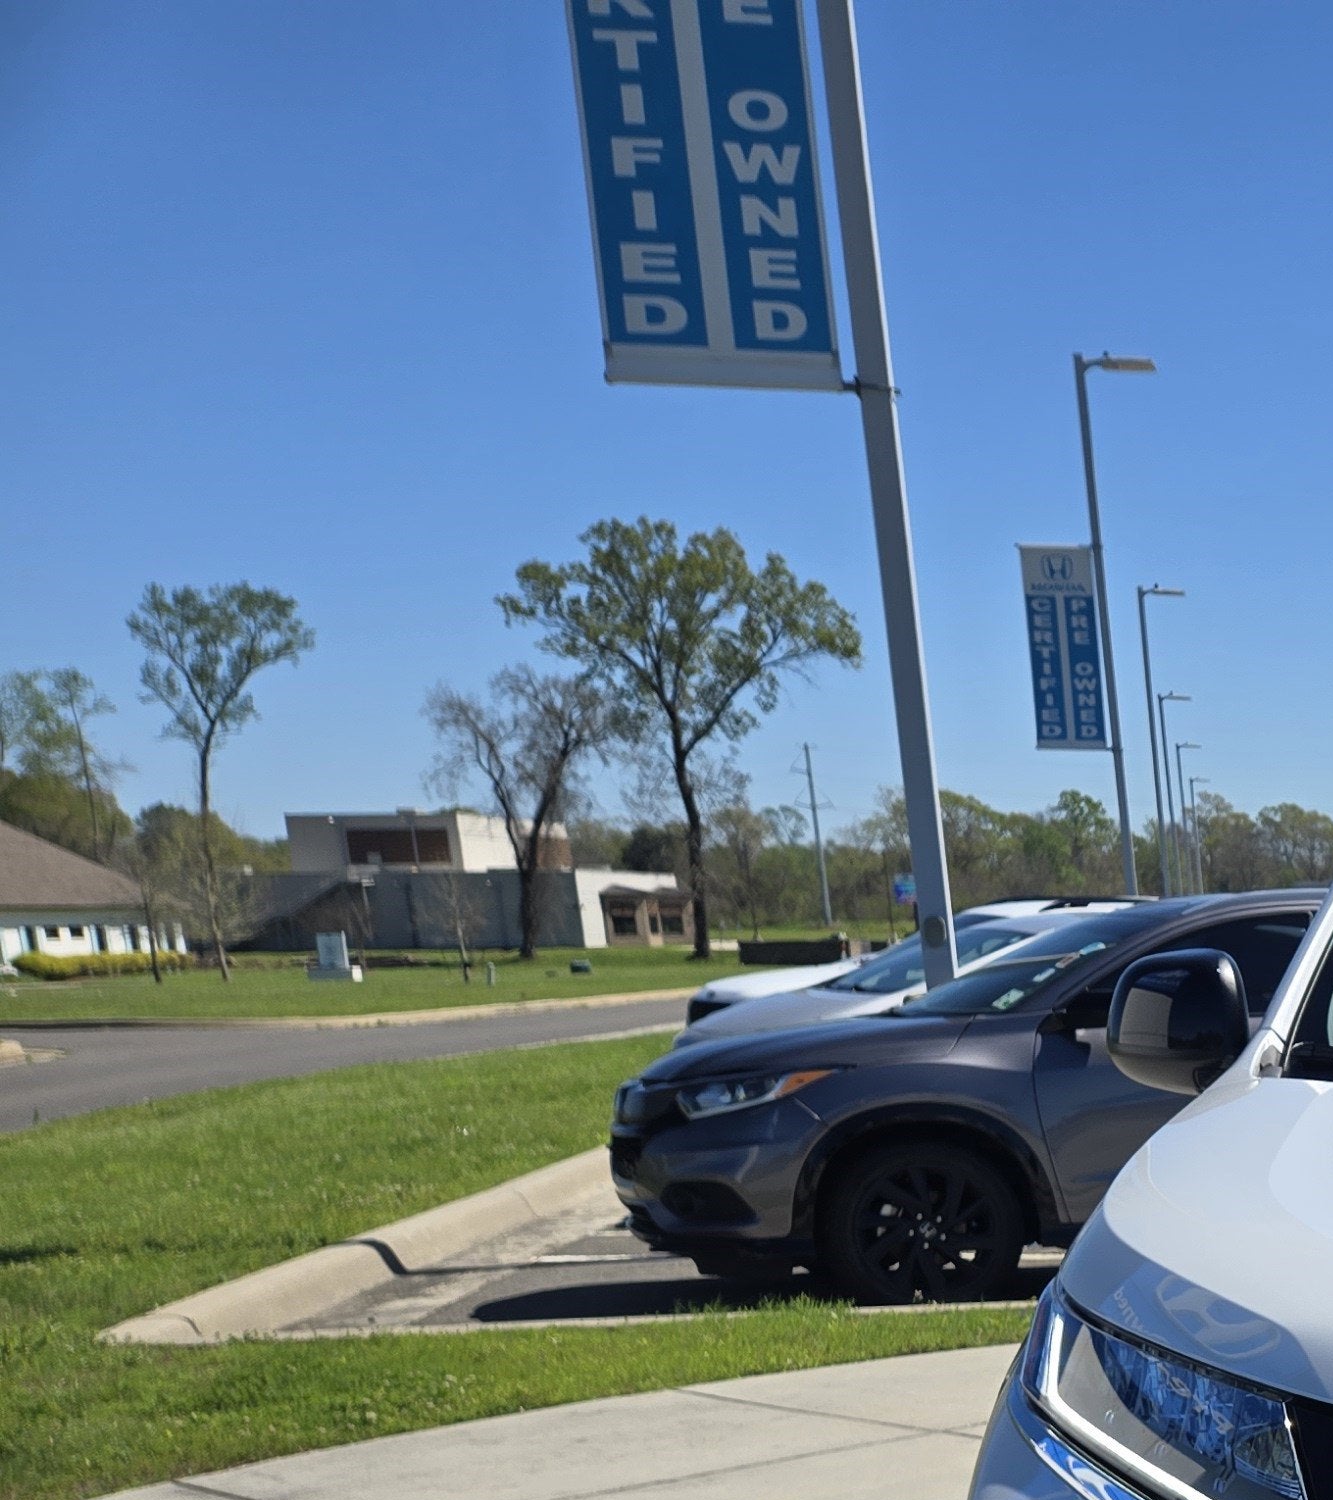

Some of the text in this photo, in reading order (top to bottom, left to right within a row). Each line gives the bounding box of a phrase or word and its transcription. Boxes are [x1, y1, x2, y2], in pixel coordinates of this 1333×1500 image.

[722, 90, 808, 342] OWNED
[1032, 597, 1062, 737] CERTIFIED
[1071, 597, 1098, 737] PRE OWNED
